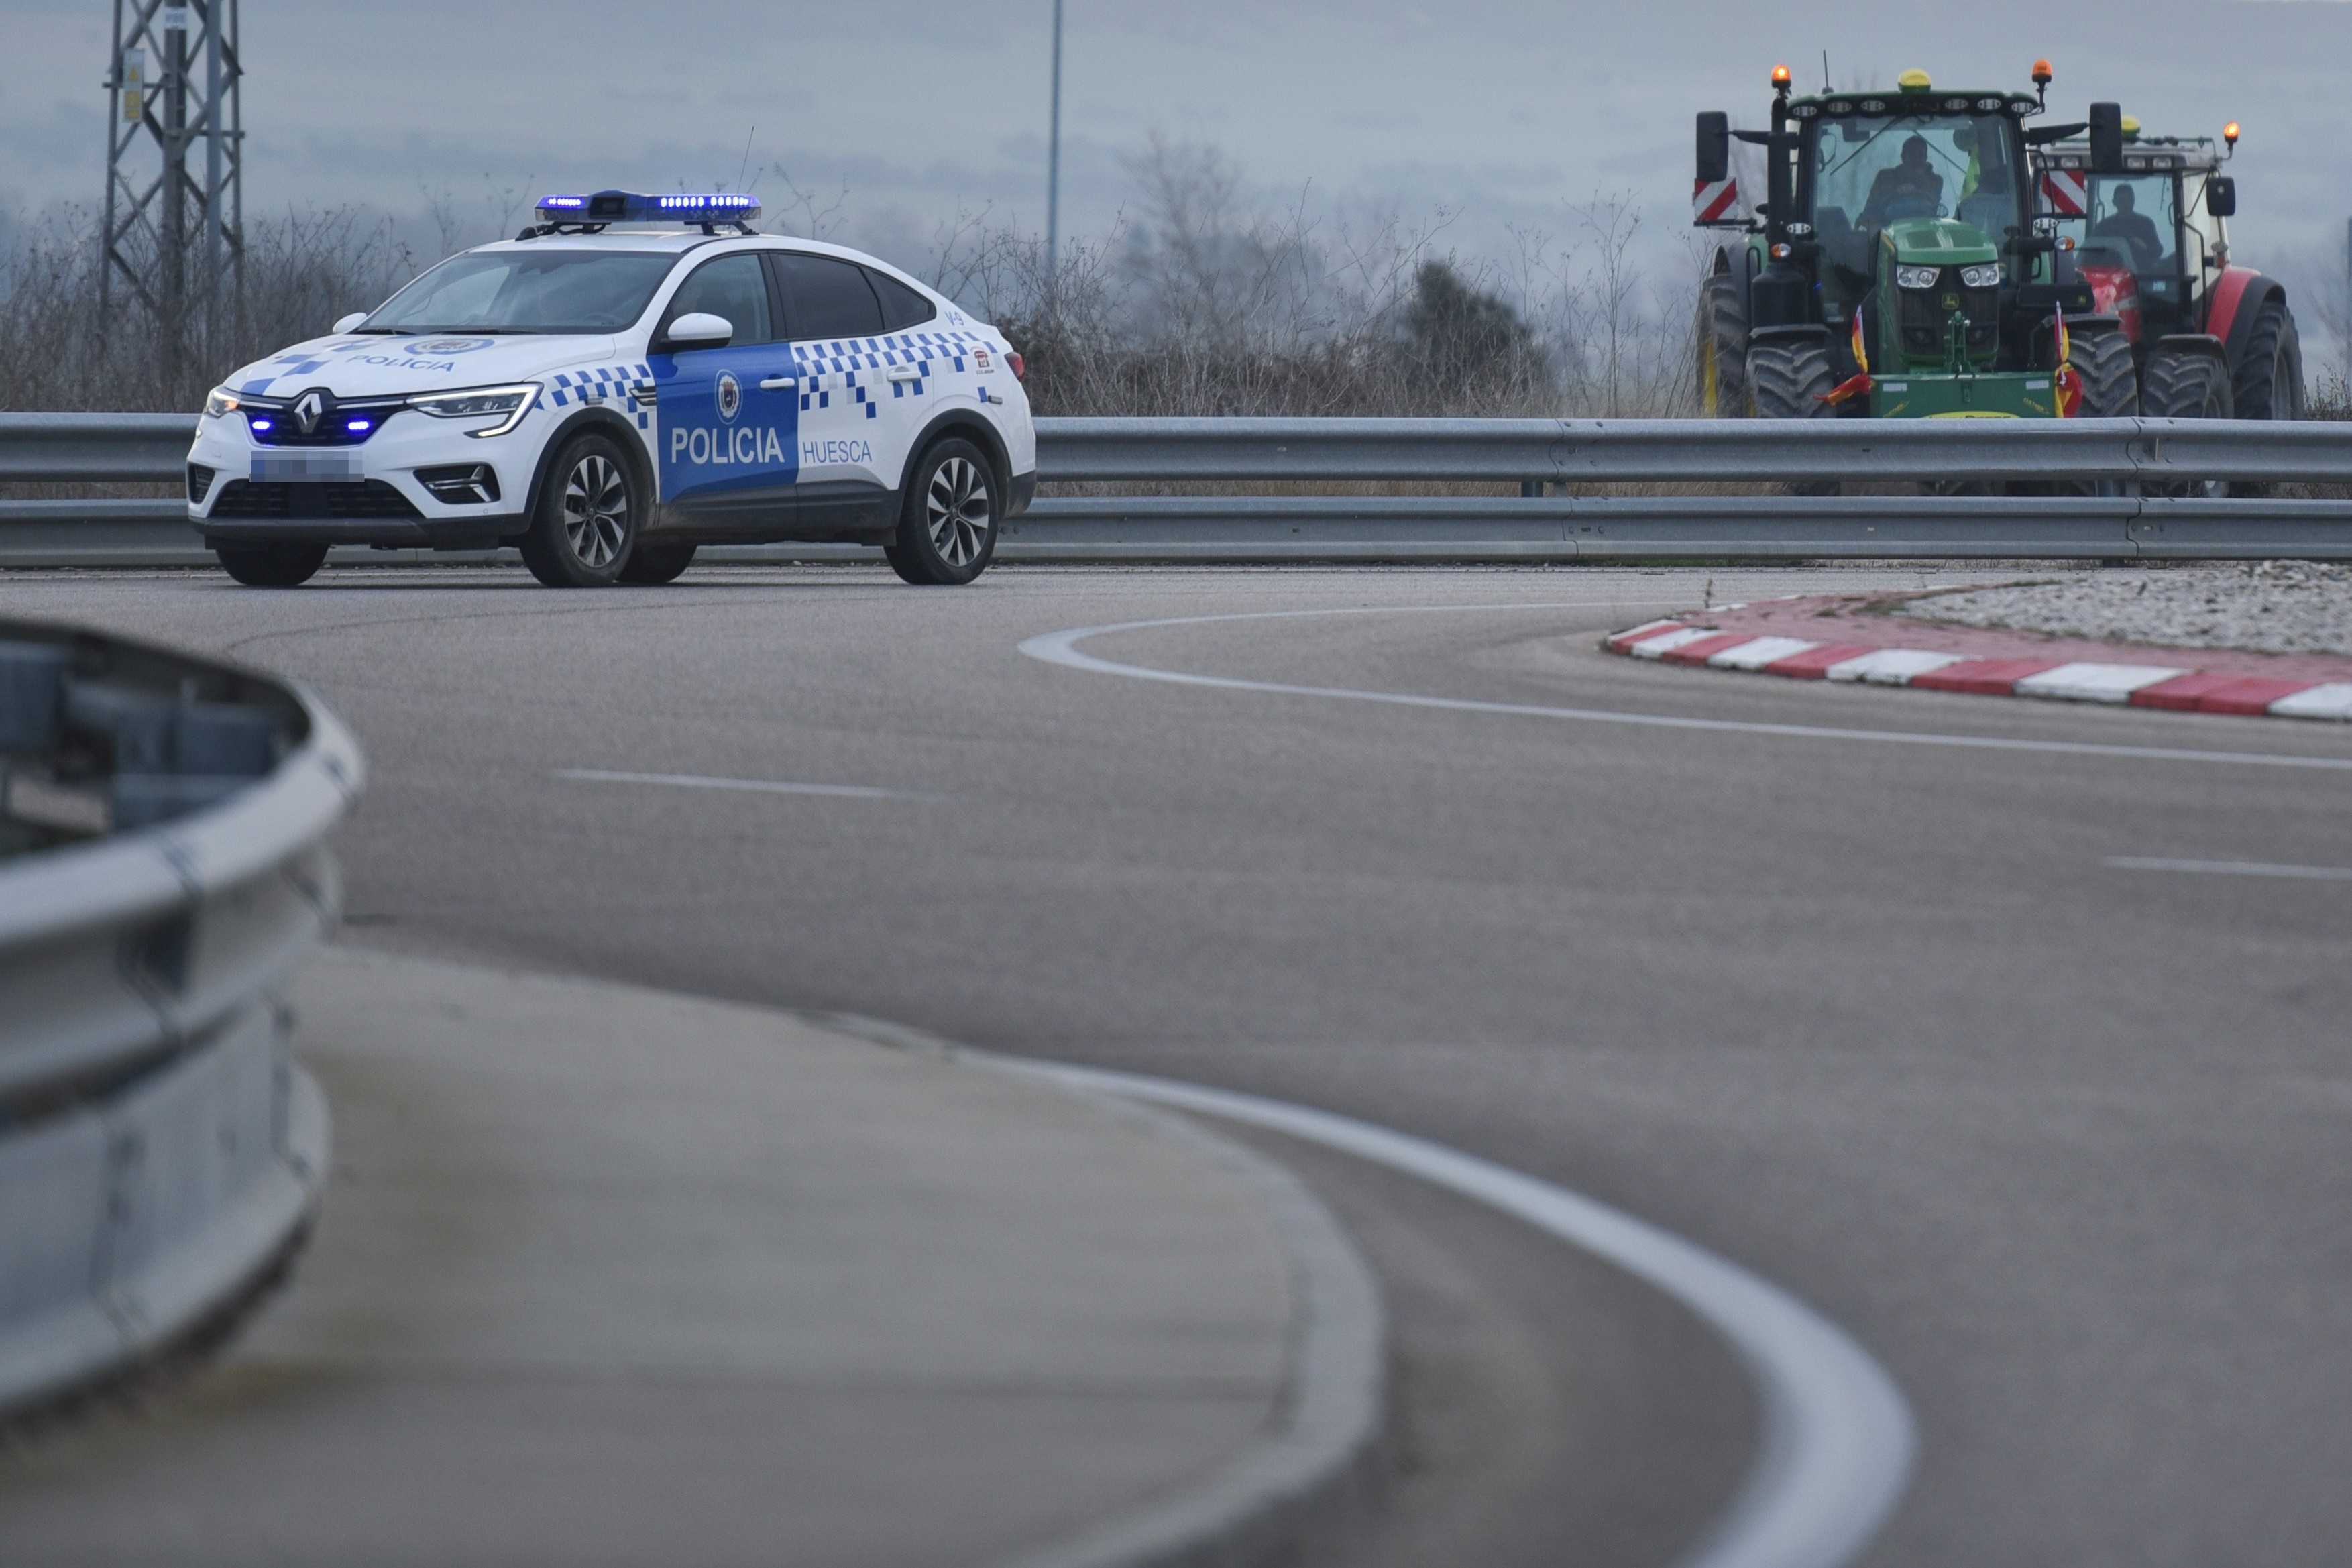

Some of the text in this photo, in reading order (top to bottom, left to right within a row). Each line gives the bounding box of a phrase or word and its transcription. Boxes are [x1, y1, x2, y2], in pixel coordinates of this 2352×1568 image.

[944, 311, 964, 326] V-9
[346, 355, 455, 372] POLICIA
[671, 427, 785, 464] POLICIA
[803, 440, 873, 463] HUESCA
